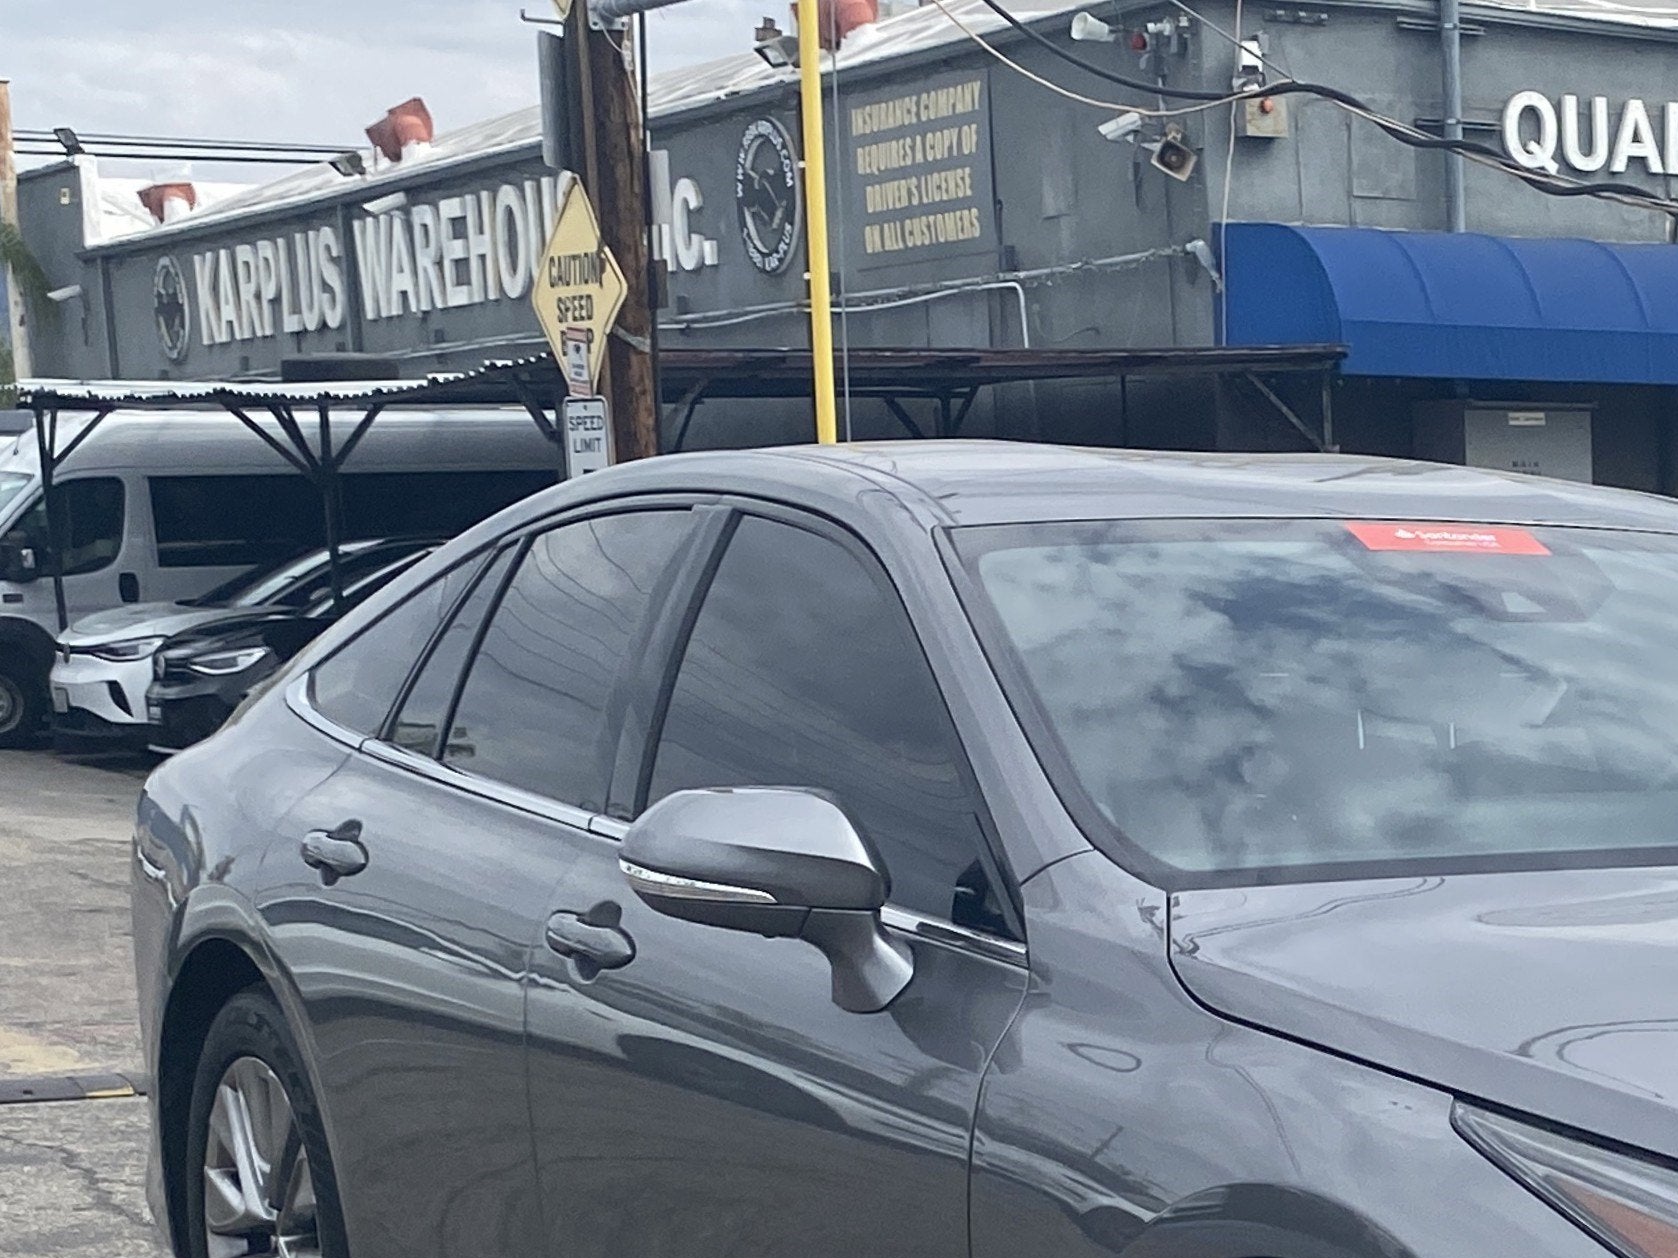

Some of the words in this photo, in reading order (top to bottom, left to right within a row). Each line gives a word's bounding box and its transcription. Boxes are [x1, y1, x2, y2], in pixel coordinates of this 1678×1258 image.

[851, 96, 918, 136] INSURANCE
[919, 80, 981, 122] COMPANY
[857, 137, 912, 175] REQUIRES
[915, 134, 924, 163] A
[926, 127, 959, 161] COPY
[961, 123, 977, 155] OF
[921, 166, 972, 204] LICENSE
[864, 224, 883, 254] ON
[883, 221, 904, 251] ALL
[905, 207, 980, 247] CUSTOMERS
[193, 226, 345, 345] KARPLUS
[353, 170, 578, 320] WAREHOU
[549, 252, 603, 288] CAUTION
[556, 294, 594, 323] SPEED
[568, 414, 605, 432] SPEED
[573, 436, 602, 454] LIMIT
